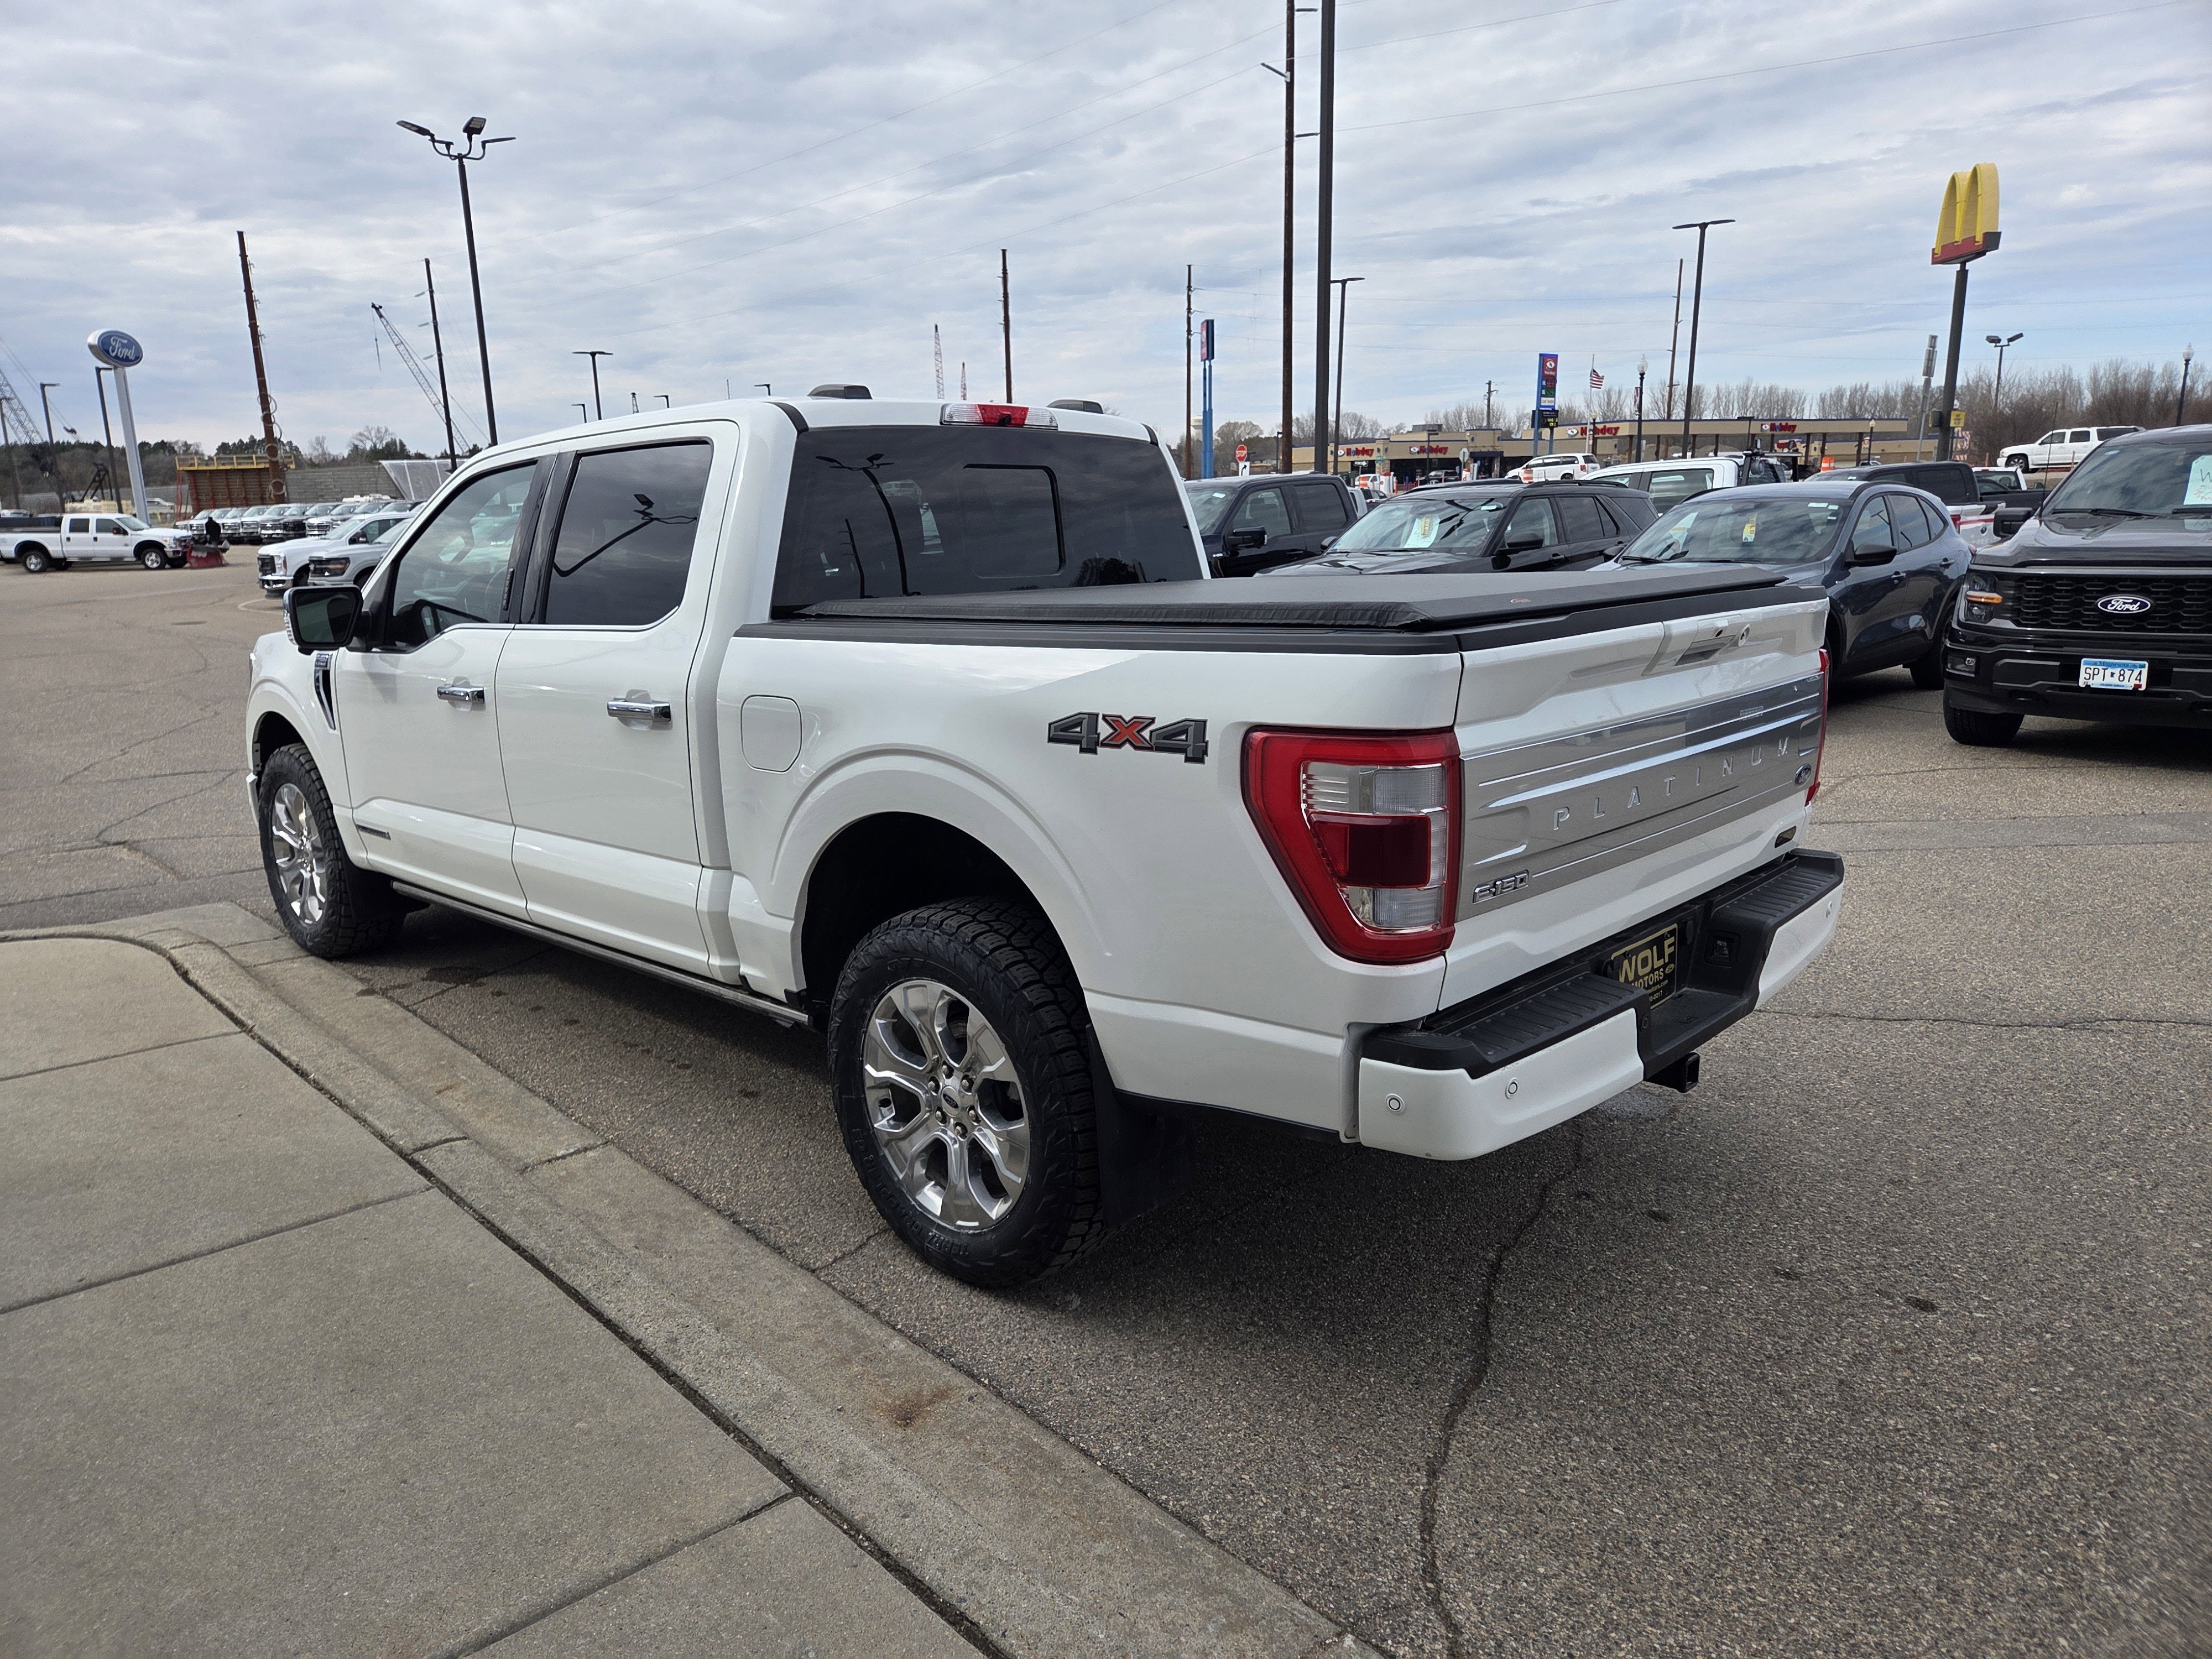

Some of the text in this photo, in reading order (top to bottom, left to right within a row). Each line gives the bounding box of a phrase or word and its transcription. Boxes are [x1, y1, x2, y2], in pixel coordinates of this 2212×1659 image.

[109, 336, 136, 361] Ford
[2107, 598, 2141, 611] Ford
[2084, 667, 2142, 683] SPT 874
[1553, 736, 1789, 831] PLATINUM
[1472, 870, 1529, 904] F-150
[1619, 936, 1675, 983] WOLF
